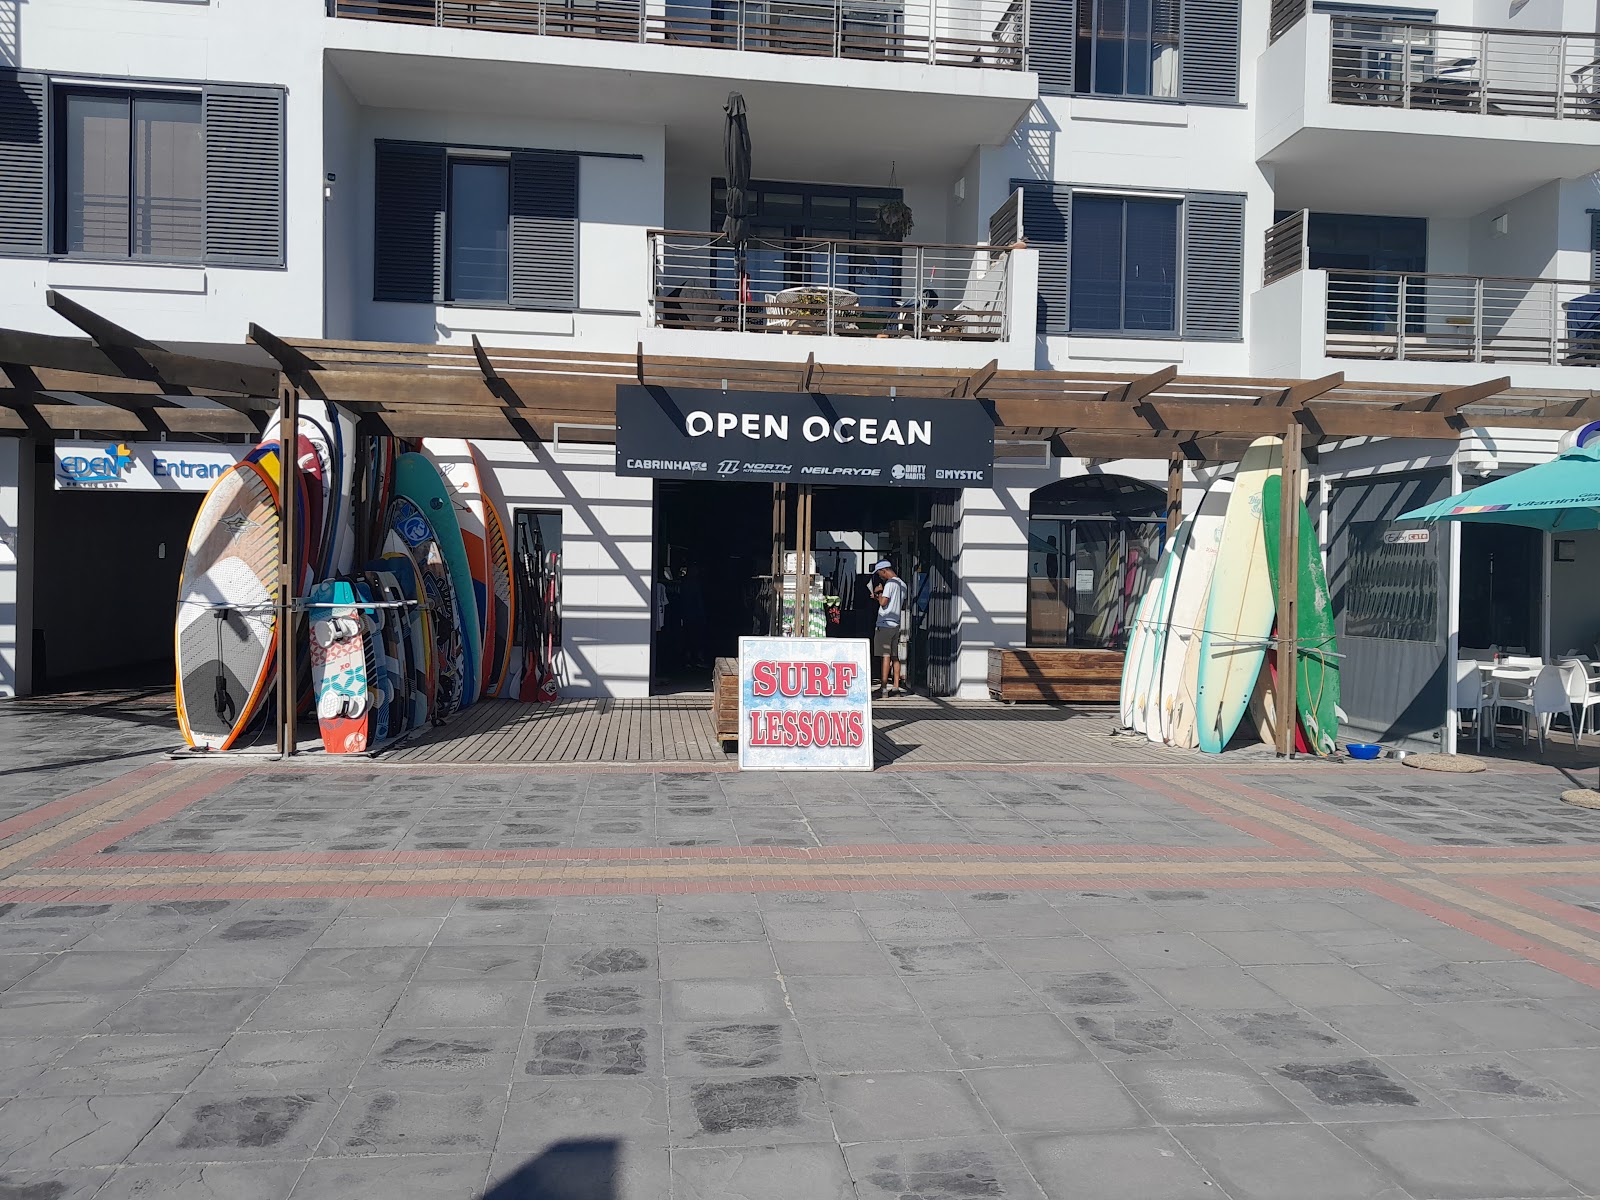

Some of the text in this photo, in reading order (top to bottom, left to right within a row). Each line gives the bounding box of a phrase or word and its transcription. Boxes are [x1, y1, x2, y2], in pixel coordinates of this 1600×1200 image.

[685, 410, 932, 446] OPEN OCEAN
[61, 456, 119, 475] EDEN
[153, 458, 233, 479] Entran
[626, 459, 693, 471] CABRINHA
[742, 462, 793, 470] NORTH
[905, 464, 927, 473] DIRTY
[800, 466, 882, 477] NEILPRYDE
[905, 472, 926, 480] HABITS
[944, 469, 984, 480] MYSTIC
[1517, 496, 1600, 507] vitaminwa
[753, 660, 858, 697] SURF
[749, 710, 864, 748] LESSONS
